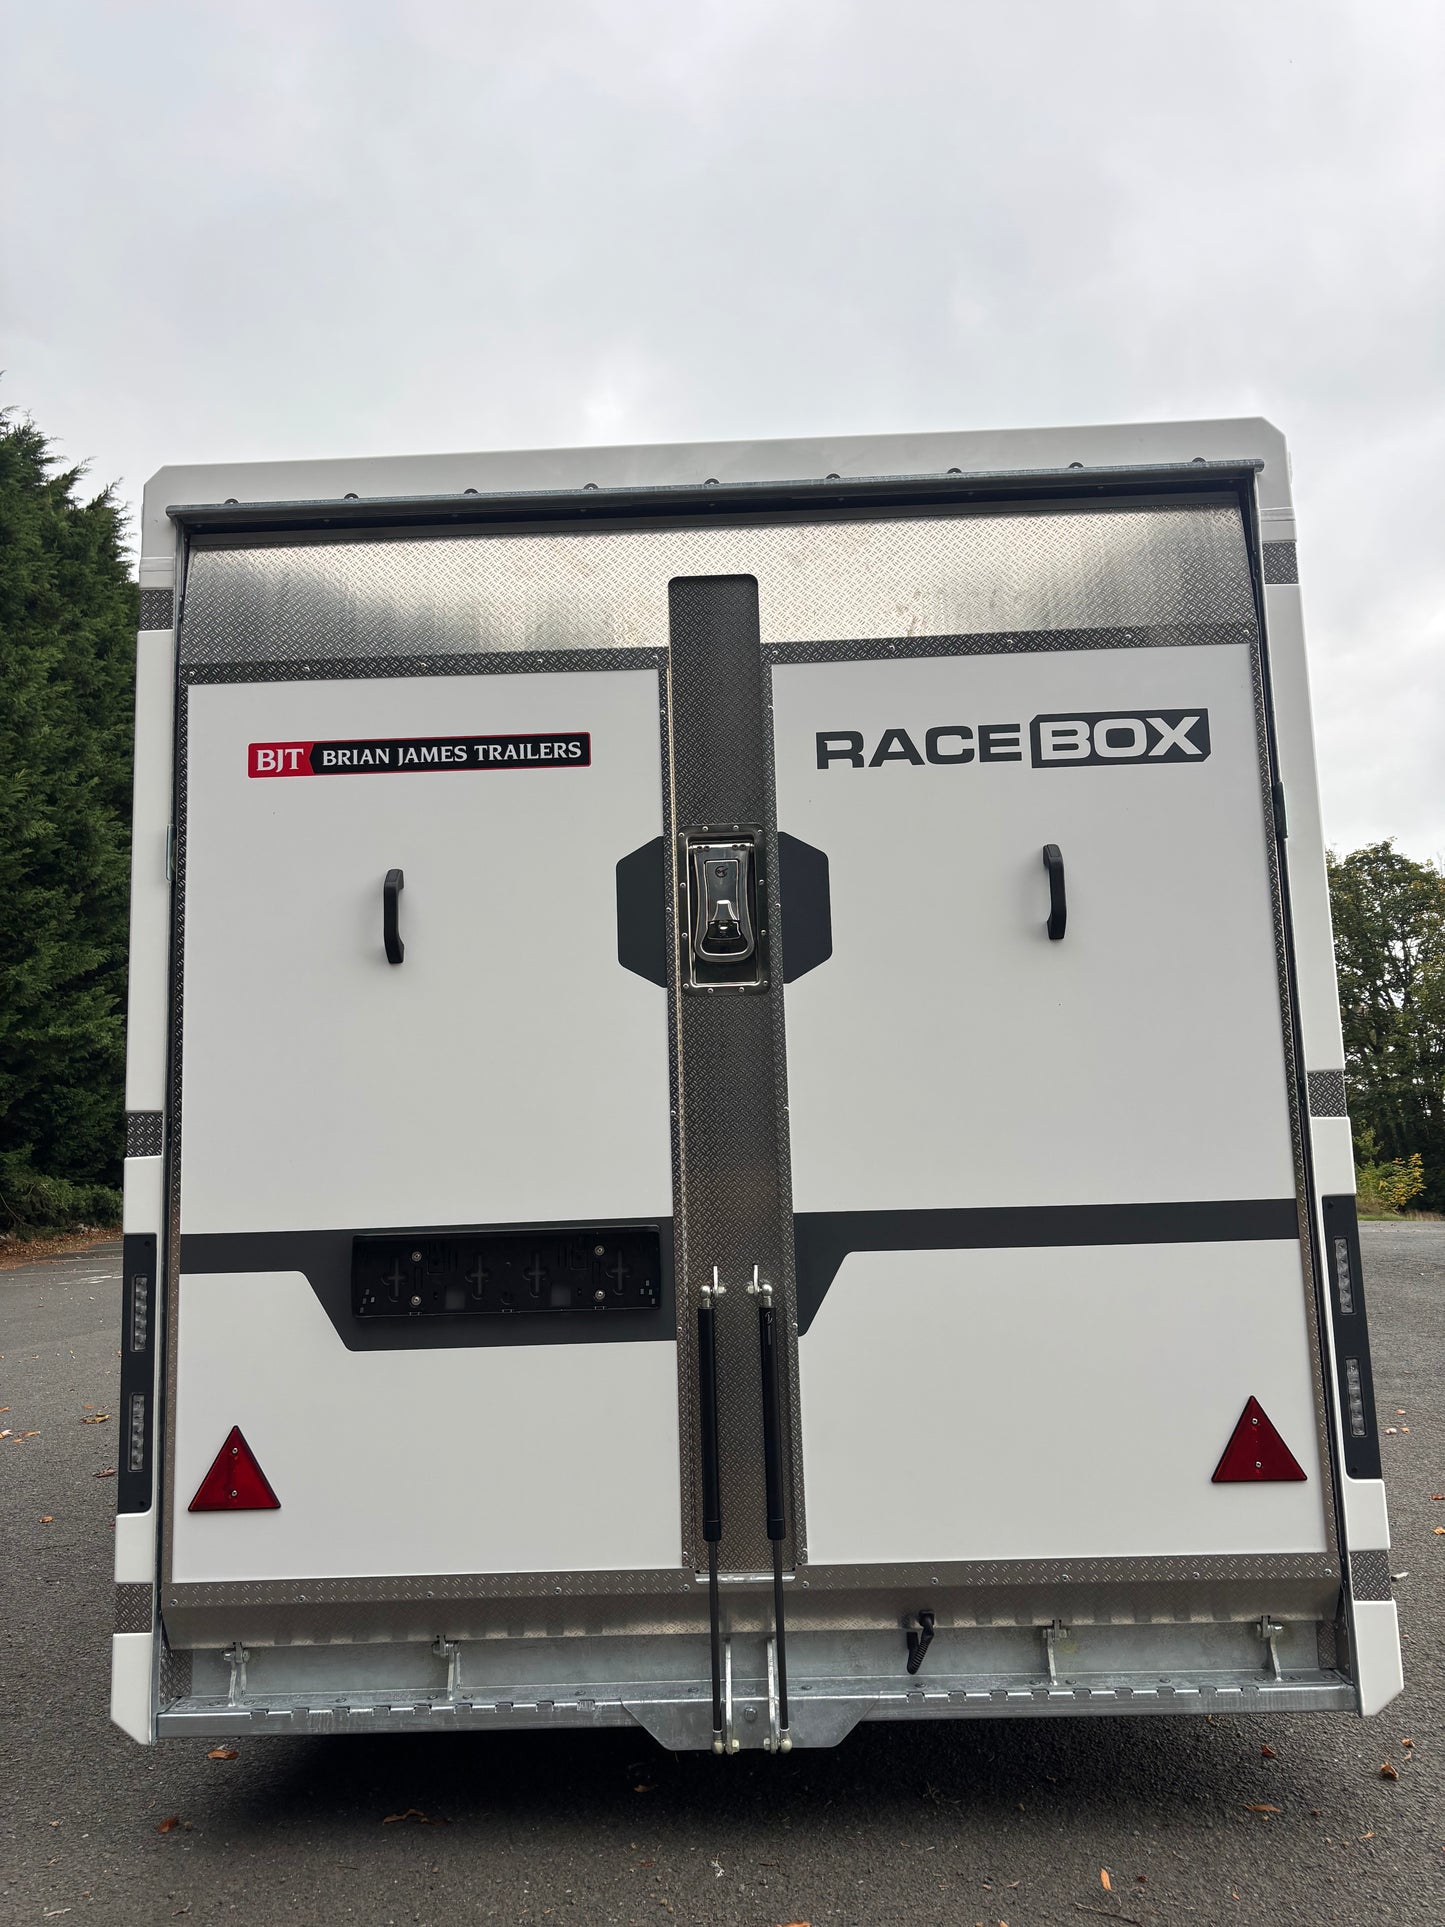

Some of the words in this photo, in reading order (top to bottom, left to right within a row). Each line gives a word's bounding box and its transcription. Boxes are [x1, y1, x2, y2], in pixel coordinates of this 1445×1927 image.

[256, 748, 304, 773] BJT
[322, 748, 390, 766] BRIAN
[397, 745, 468, 767] JAMES
[474, 741, 582, 761] TRAILERS
